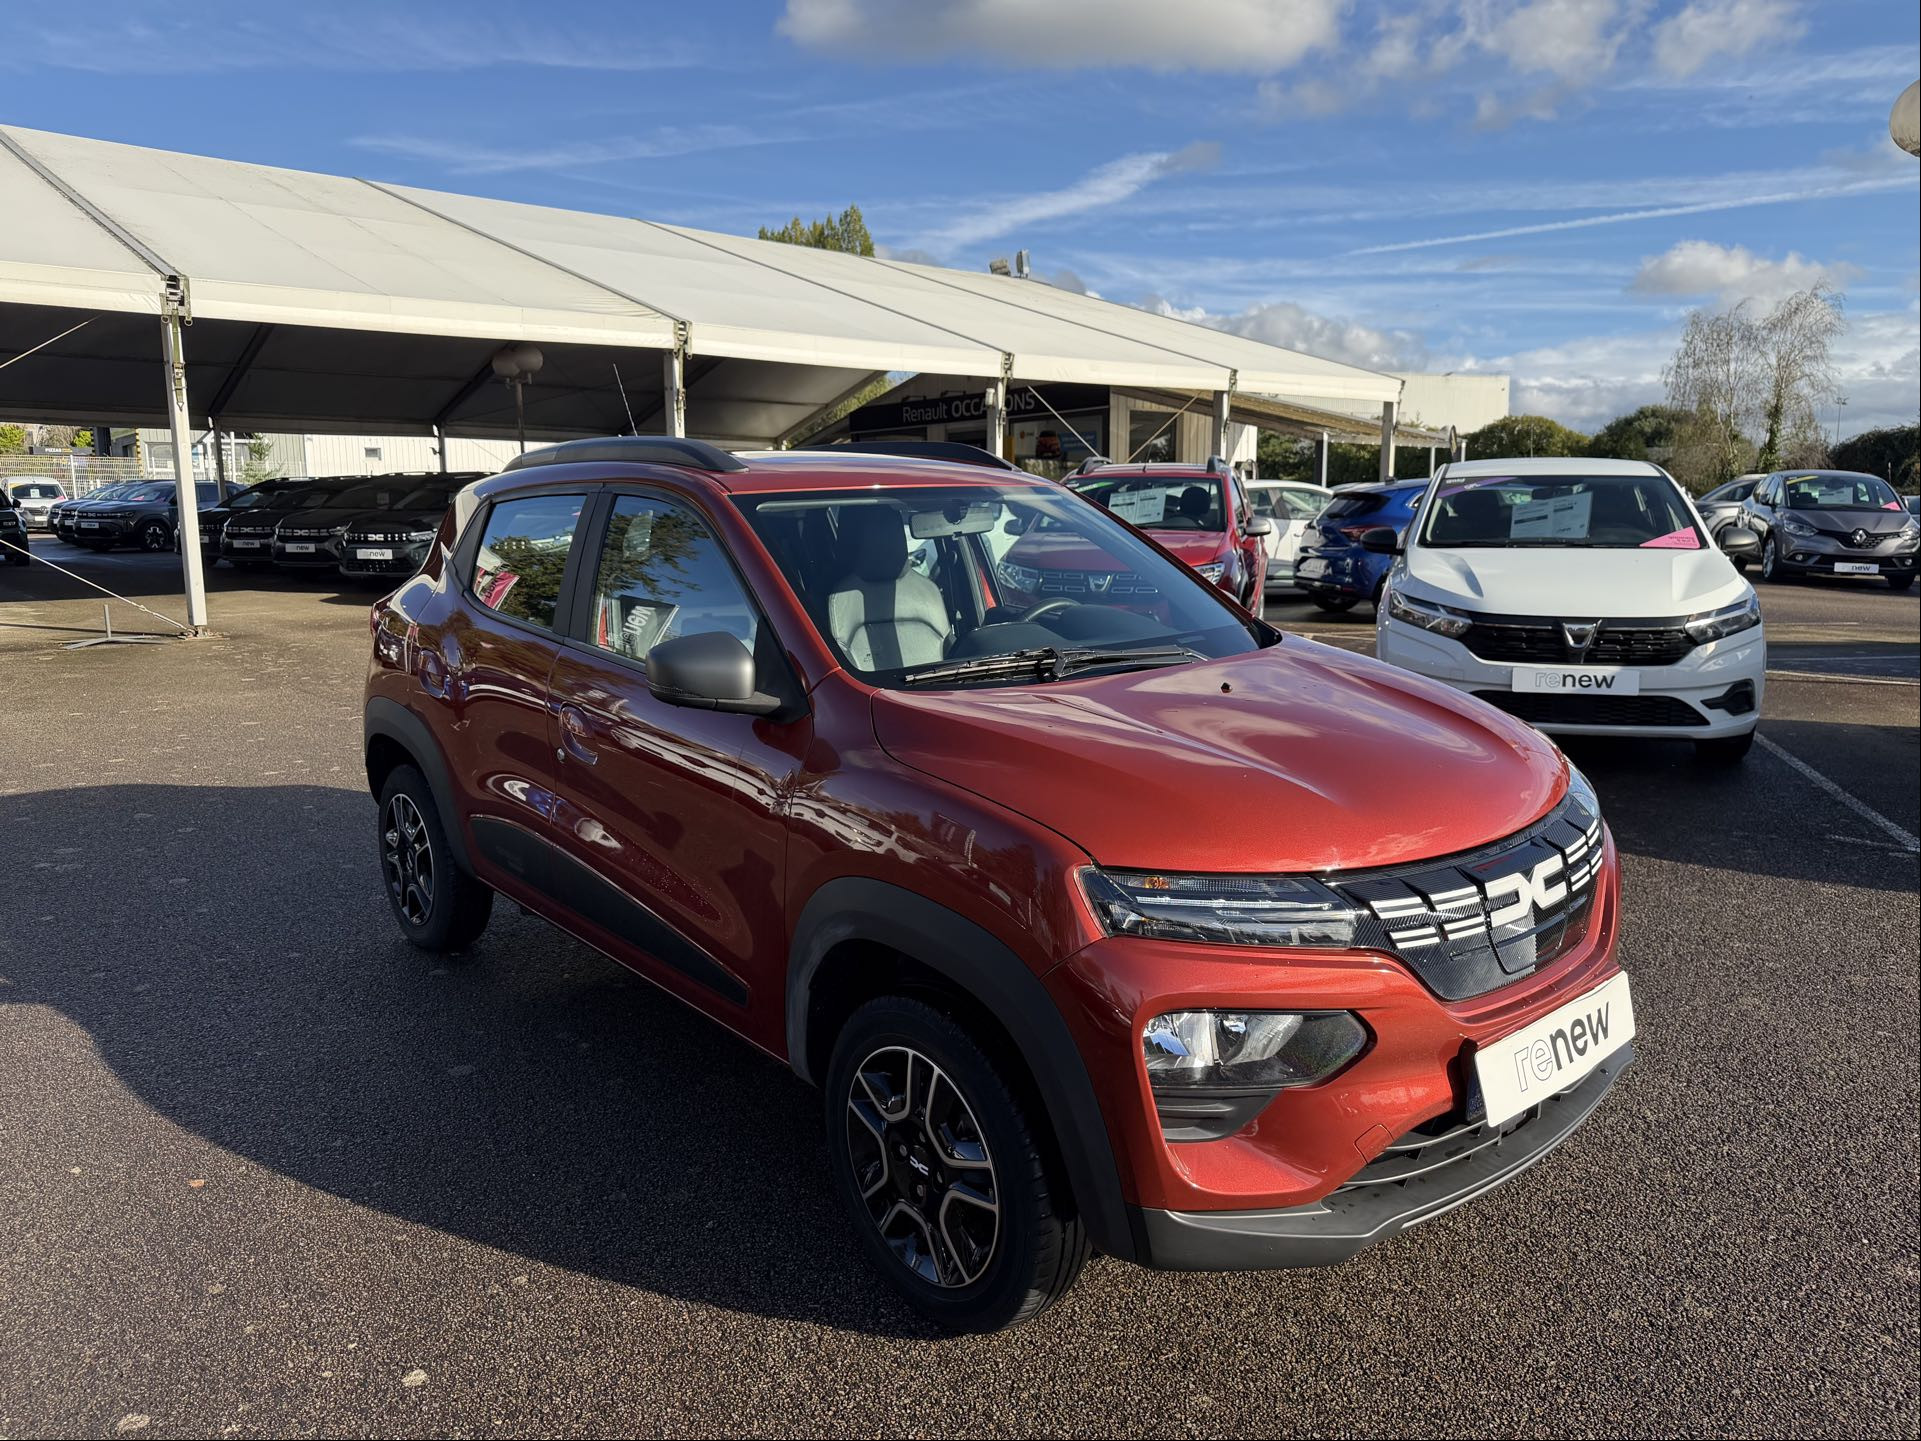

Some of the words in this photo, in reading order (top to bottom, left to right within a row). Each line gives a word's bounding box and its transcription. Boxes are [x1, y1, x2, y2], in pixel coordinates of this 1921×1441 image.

[903, 402, 947, 423] Renault
[952, 392, 1035, 418] OCCAONS
[1535, 672, 1616, 689] renew
[1514, 1001, 1610, 1093] renew
